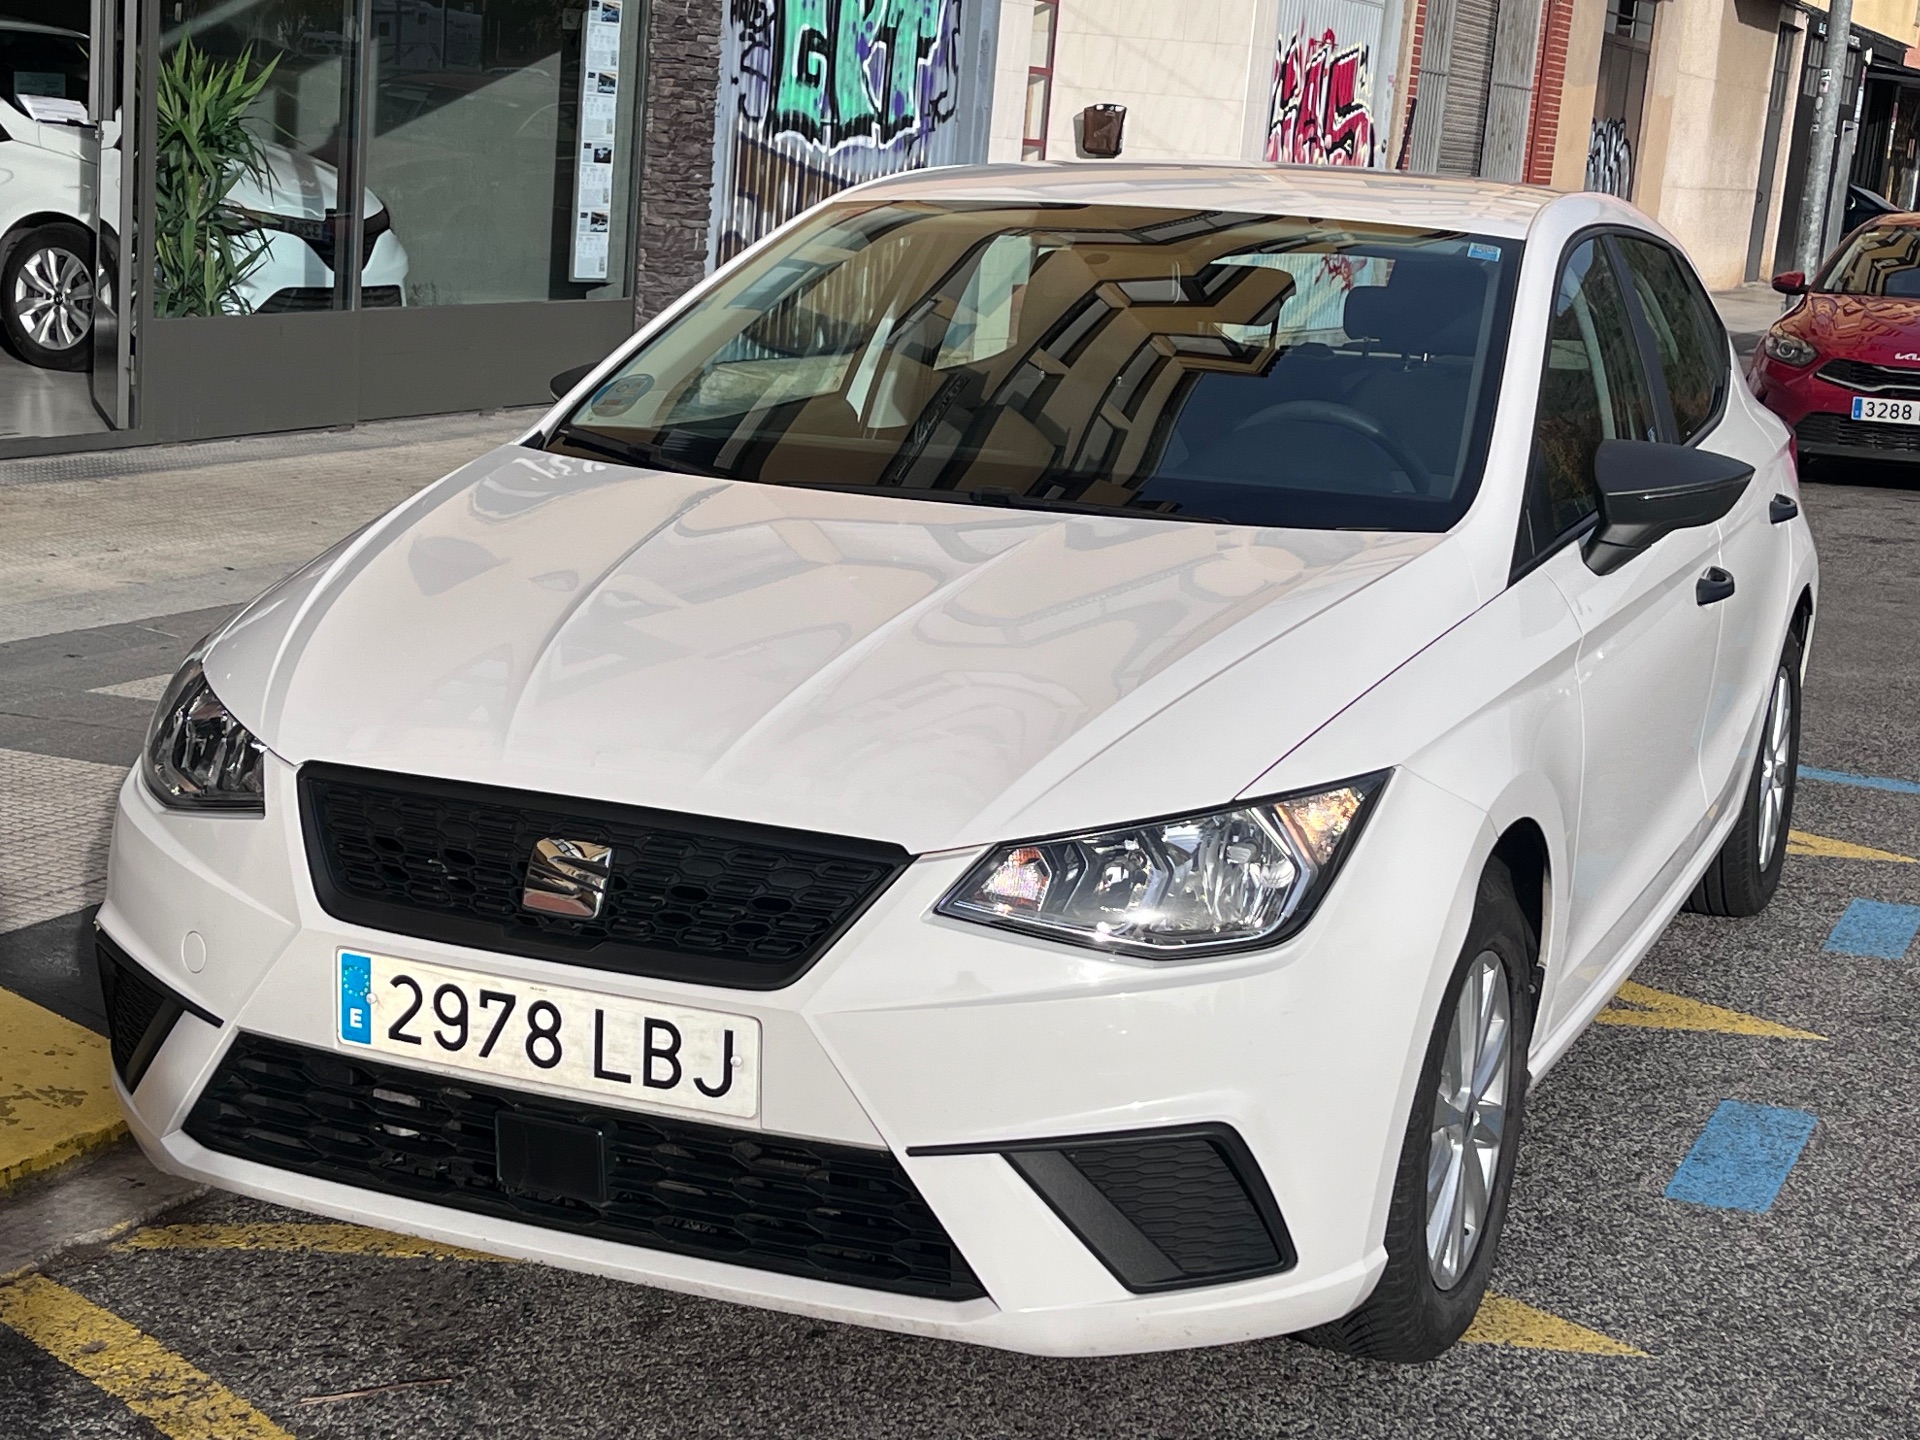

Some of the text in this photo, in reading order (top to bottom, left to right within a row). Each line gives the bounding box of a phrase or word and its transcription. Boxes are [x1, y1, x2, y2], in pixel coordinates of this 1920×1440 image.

[1864, 401, 1912, 420] 3288
[349, 974, 734, 1098] E 2978 LBJ
